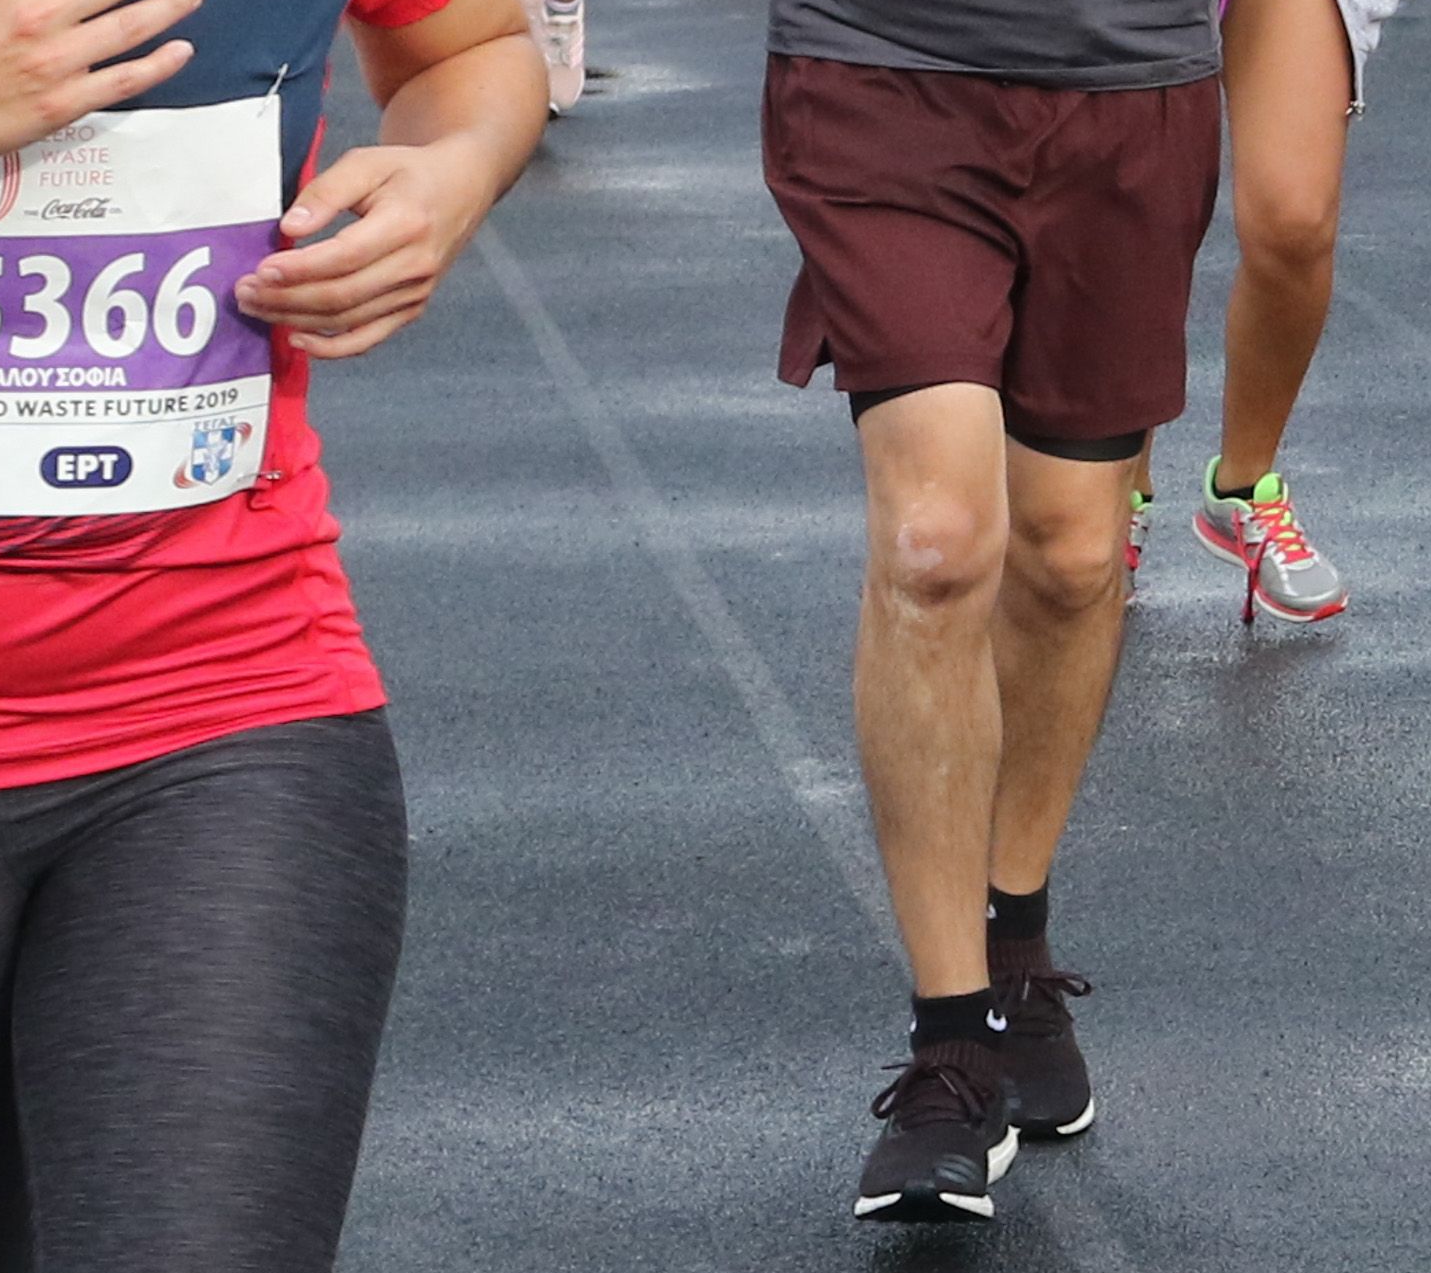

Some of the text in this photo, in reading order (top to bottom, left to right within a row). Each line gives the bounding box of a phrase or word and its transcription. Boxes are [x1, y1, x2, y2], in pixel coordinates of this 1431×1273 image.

[42, 148, 110, 164] WASTE
[39, 170, 114, 186] FUTURE
[55, 366, 127, 387] ΣΟΦΙΑ
[15, 399, 97, 417] WASTE
[104, 395, 188, 416] FUTURE
[193, 388, 239, 410] 2019
[56, 453, 119, 481] ΕΡΤ
